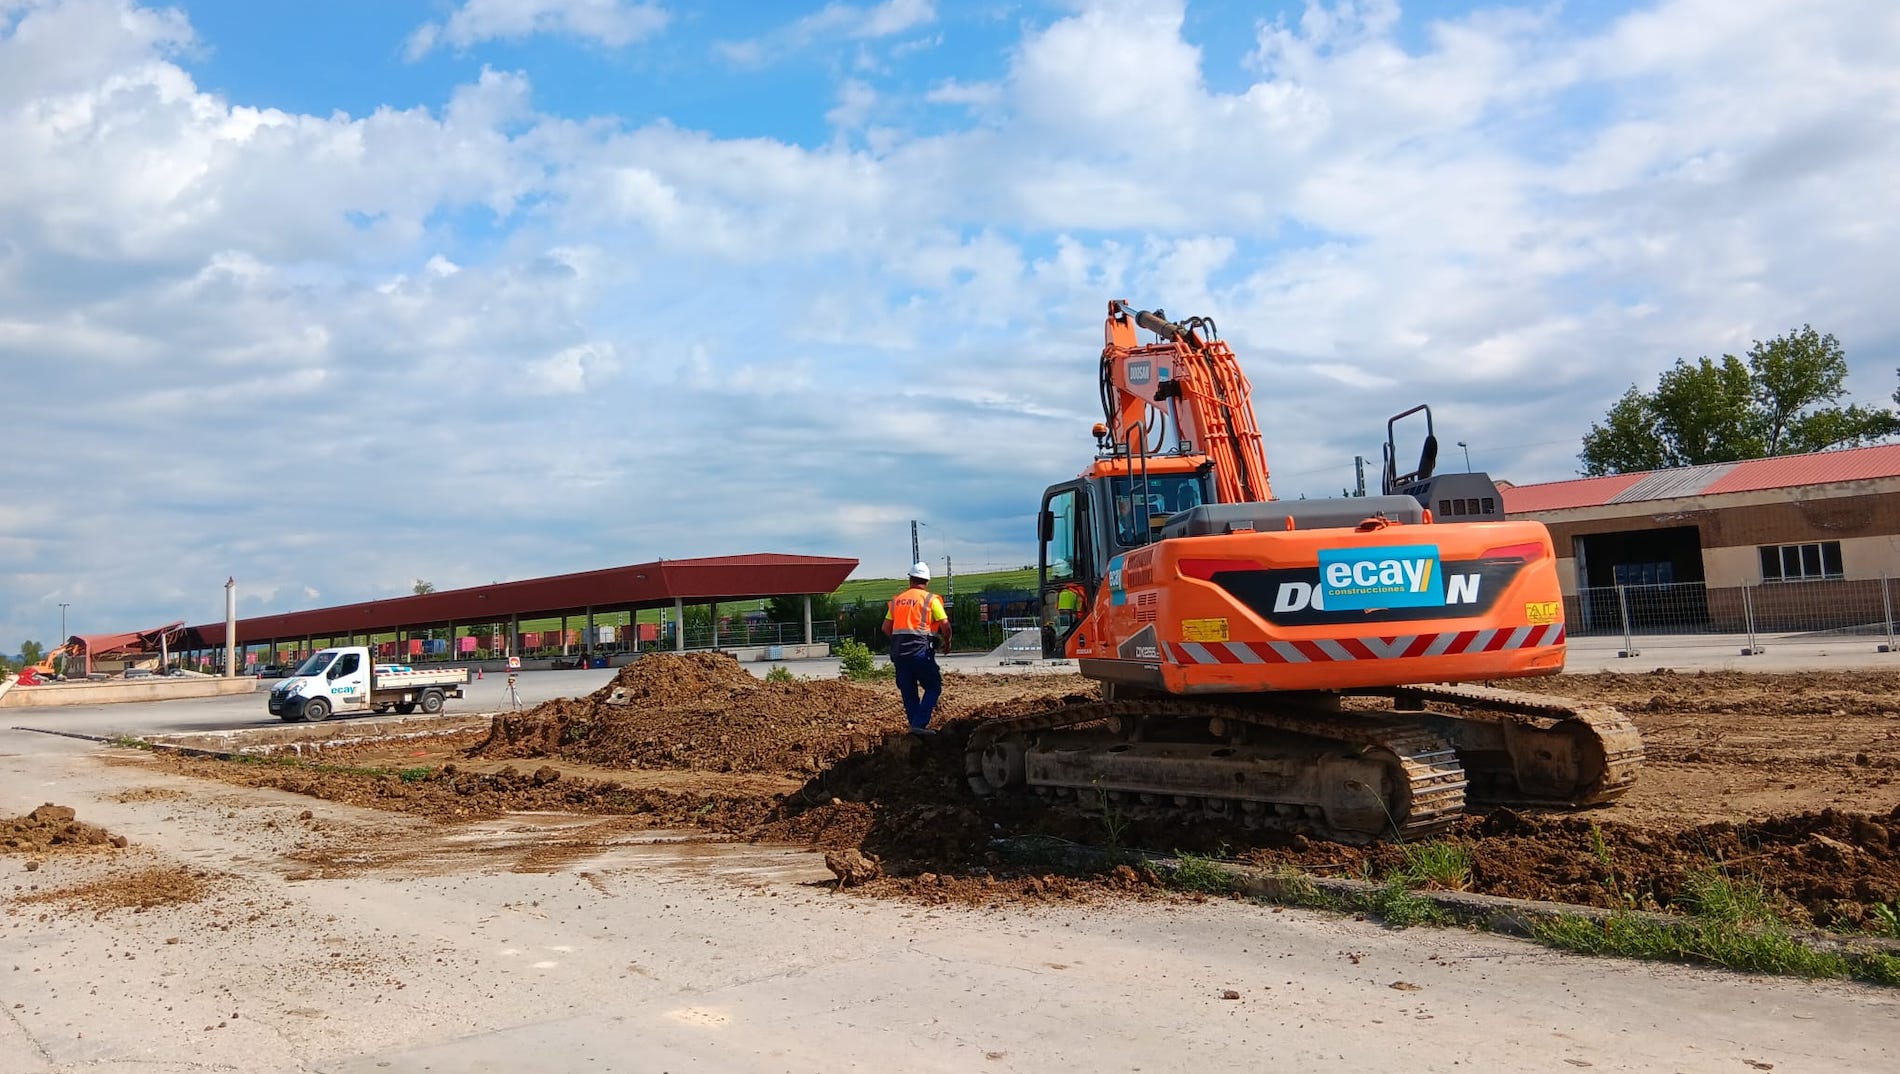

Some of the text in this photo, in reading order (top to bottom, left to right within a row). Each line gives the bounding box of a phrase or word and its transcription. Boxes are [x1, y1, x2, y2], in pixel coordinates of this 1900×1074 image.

[1326, 558, 1425, 593] ecay
[1328, 586, 1405, 596] construcciones
[331, 686, 355, 694] ecay
